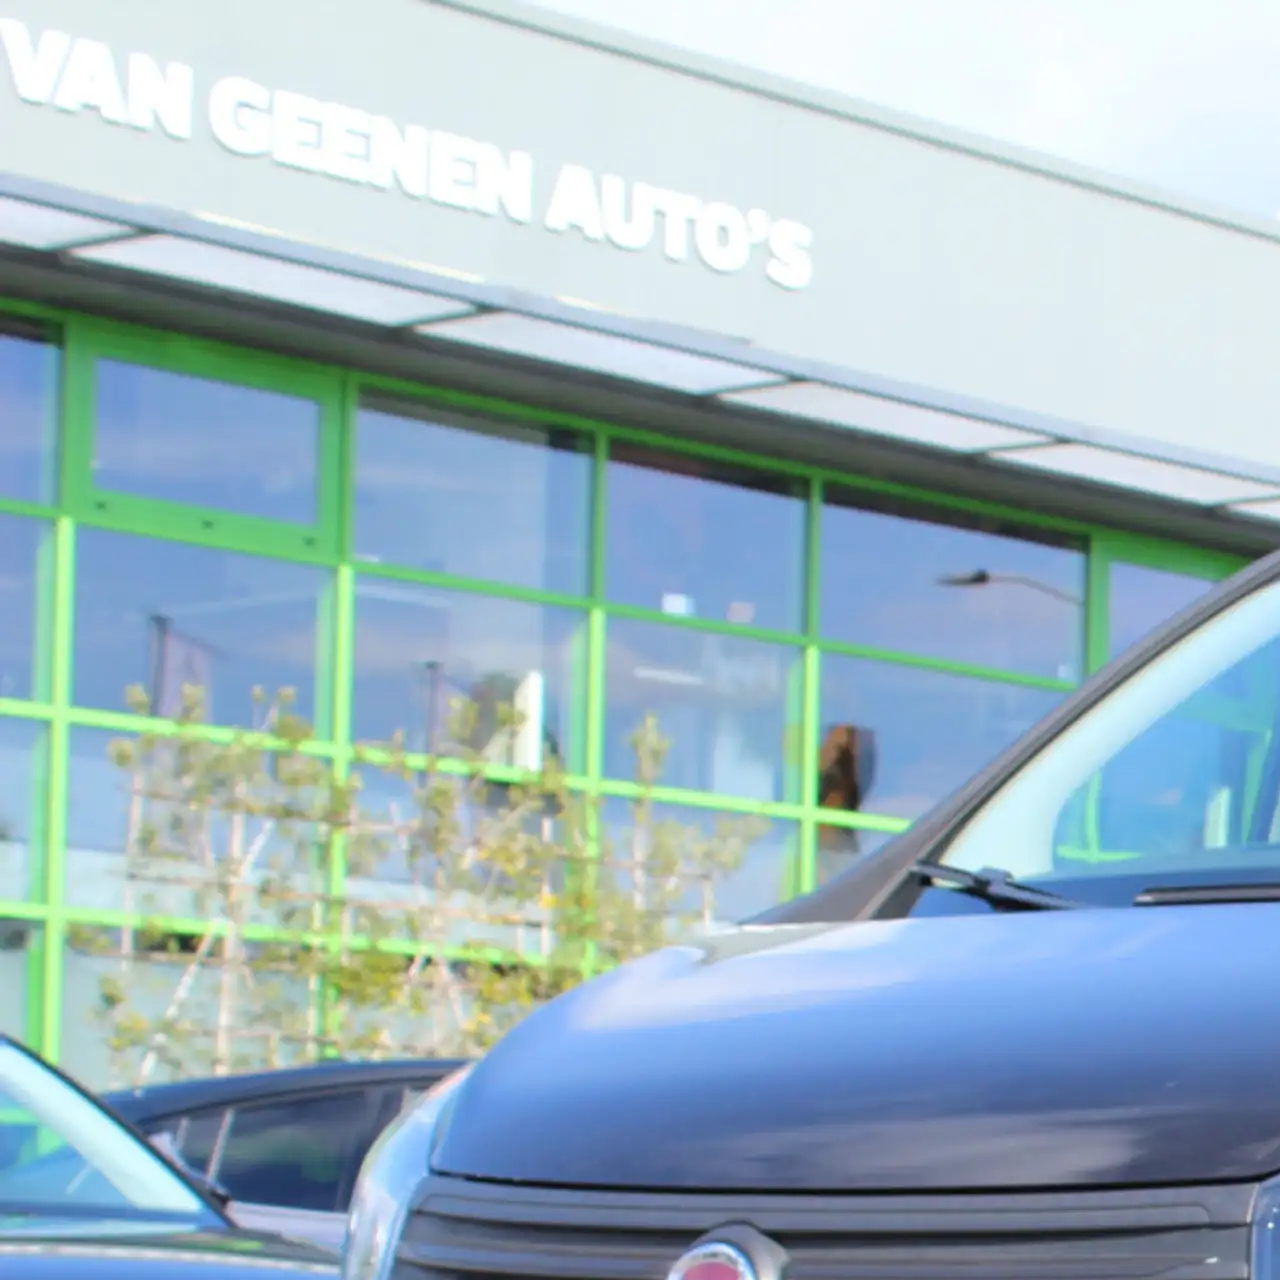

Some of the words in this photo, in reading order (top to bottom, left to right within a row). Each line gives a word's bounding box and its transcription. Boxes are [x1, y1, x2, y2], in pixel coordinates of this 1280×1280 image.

[0, 18, 193, 140] VAN
[208, 76, 533, 225] GEENEN
[543, 162, 813, 291] AUTO'S
